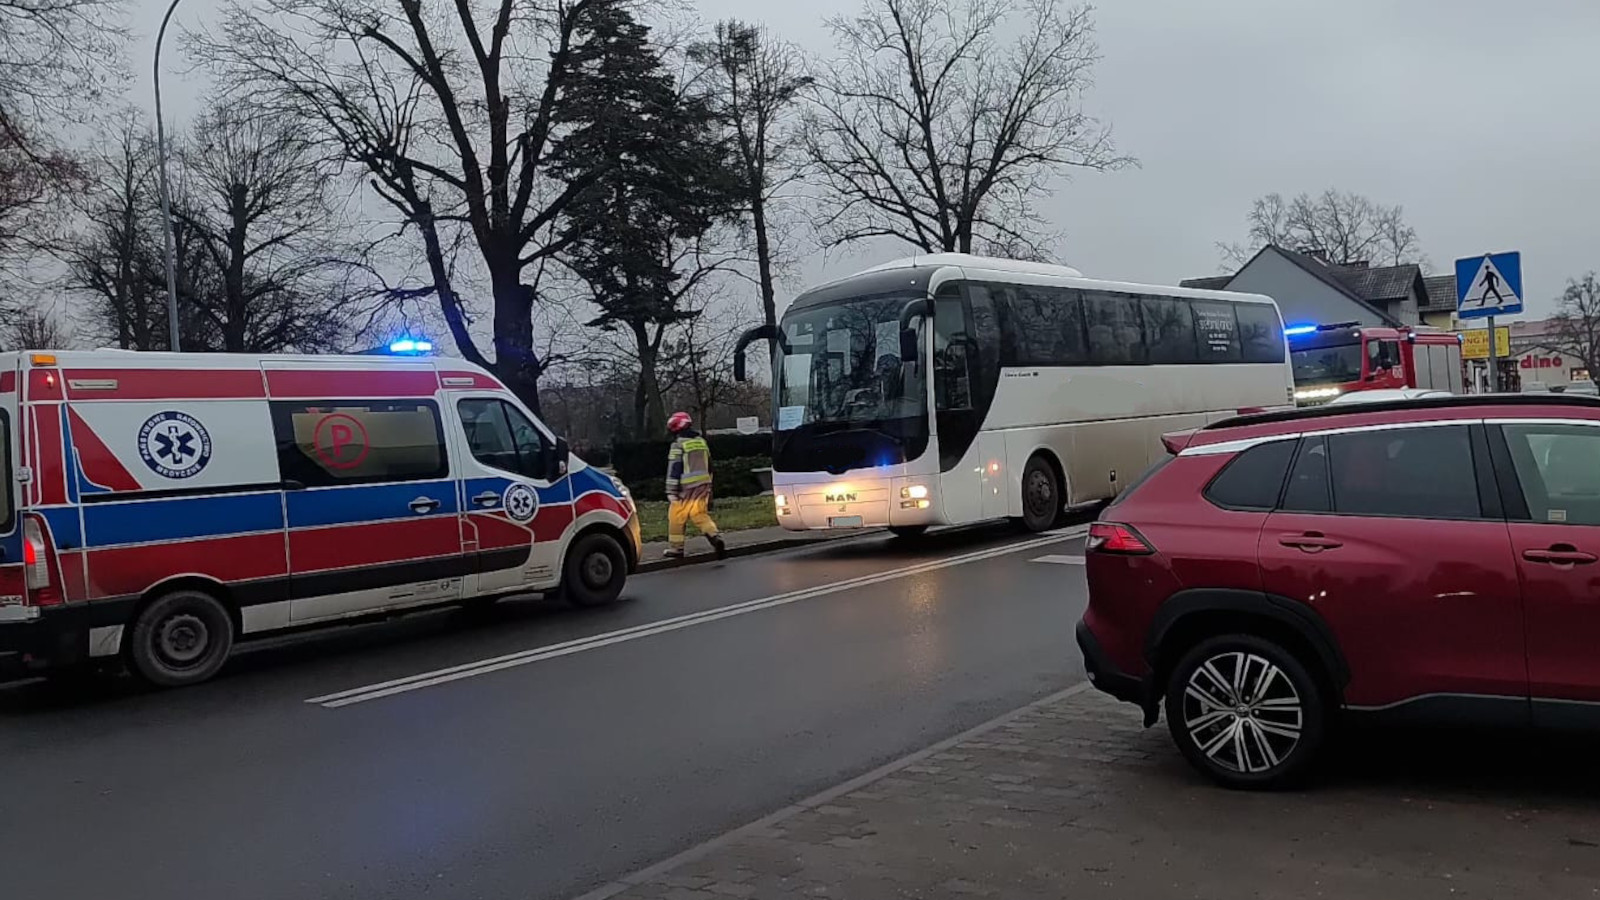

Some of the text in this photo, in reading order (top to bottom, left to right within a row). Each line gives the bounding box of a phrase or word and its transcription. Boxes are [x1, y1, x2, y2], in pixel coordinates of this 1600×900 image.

[1520, 354, 1562, 368] dino
[331, 424, 353, 457] P
[155, 463, 201, 477] MEDYCZNE
[825, 493, 858, 502] MAN
